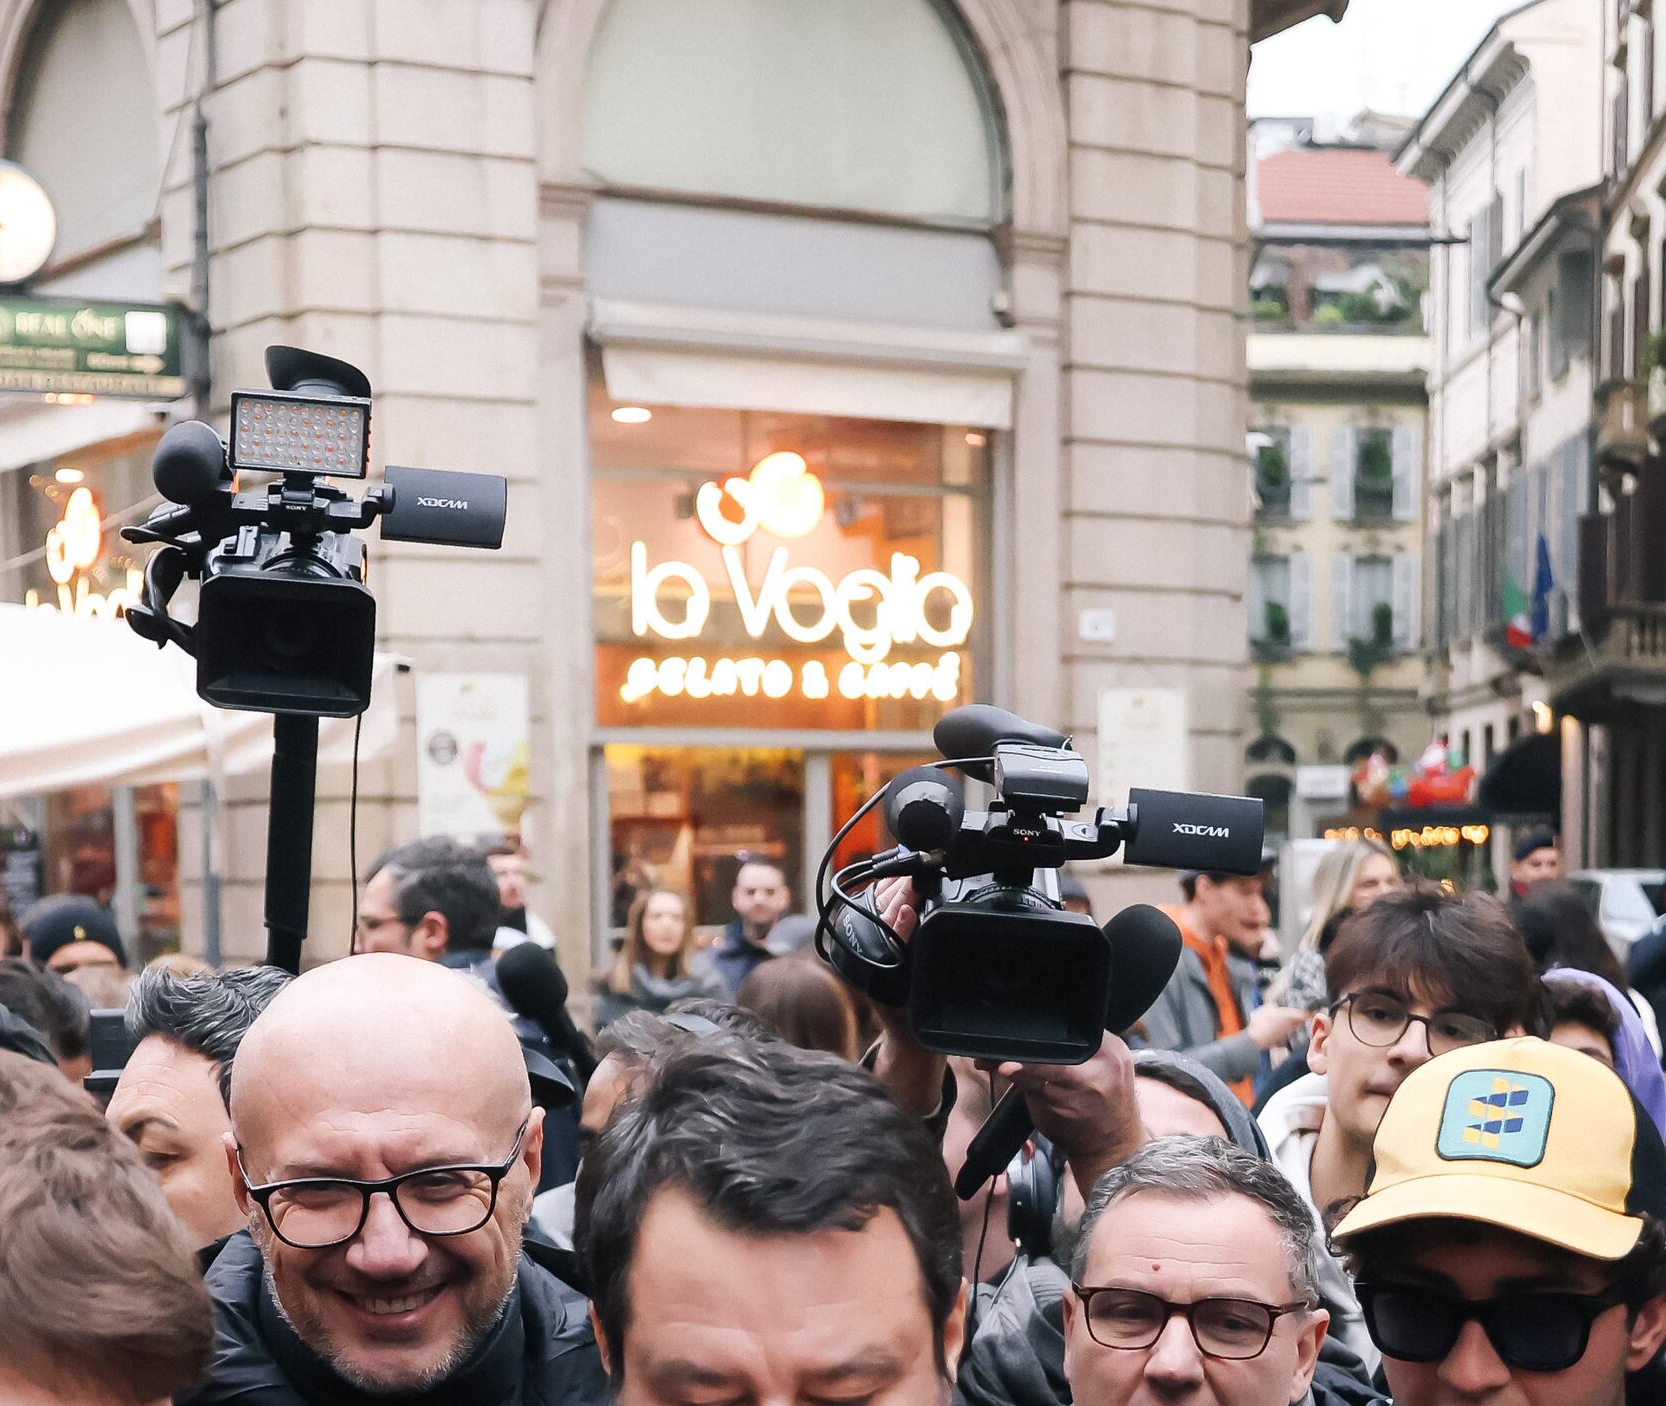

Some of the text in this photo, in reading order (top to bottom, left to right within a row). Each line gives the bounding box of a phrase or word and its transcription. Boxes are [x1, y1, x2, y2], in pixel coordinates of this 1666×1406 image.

[285, 503, 307, 512] SONY
[416, 496, 469, 510] XDCAM
[1013, 827, 1041, 837] SONY
[1171, 822, 1230, 838] XDCAM
[843, 913, 864, 954] SONY
